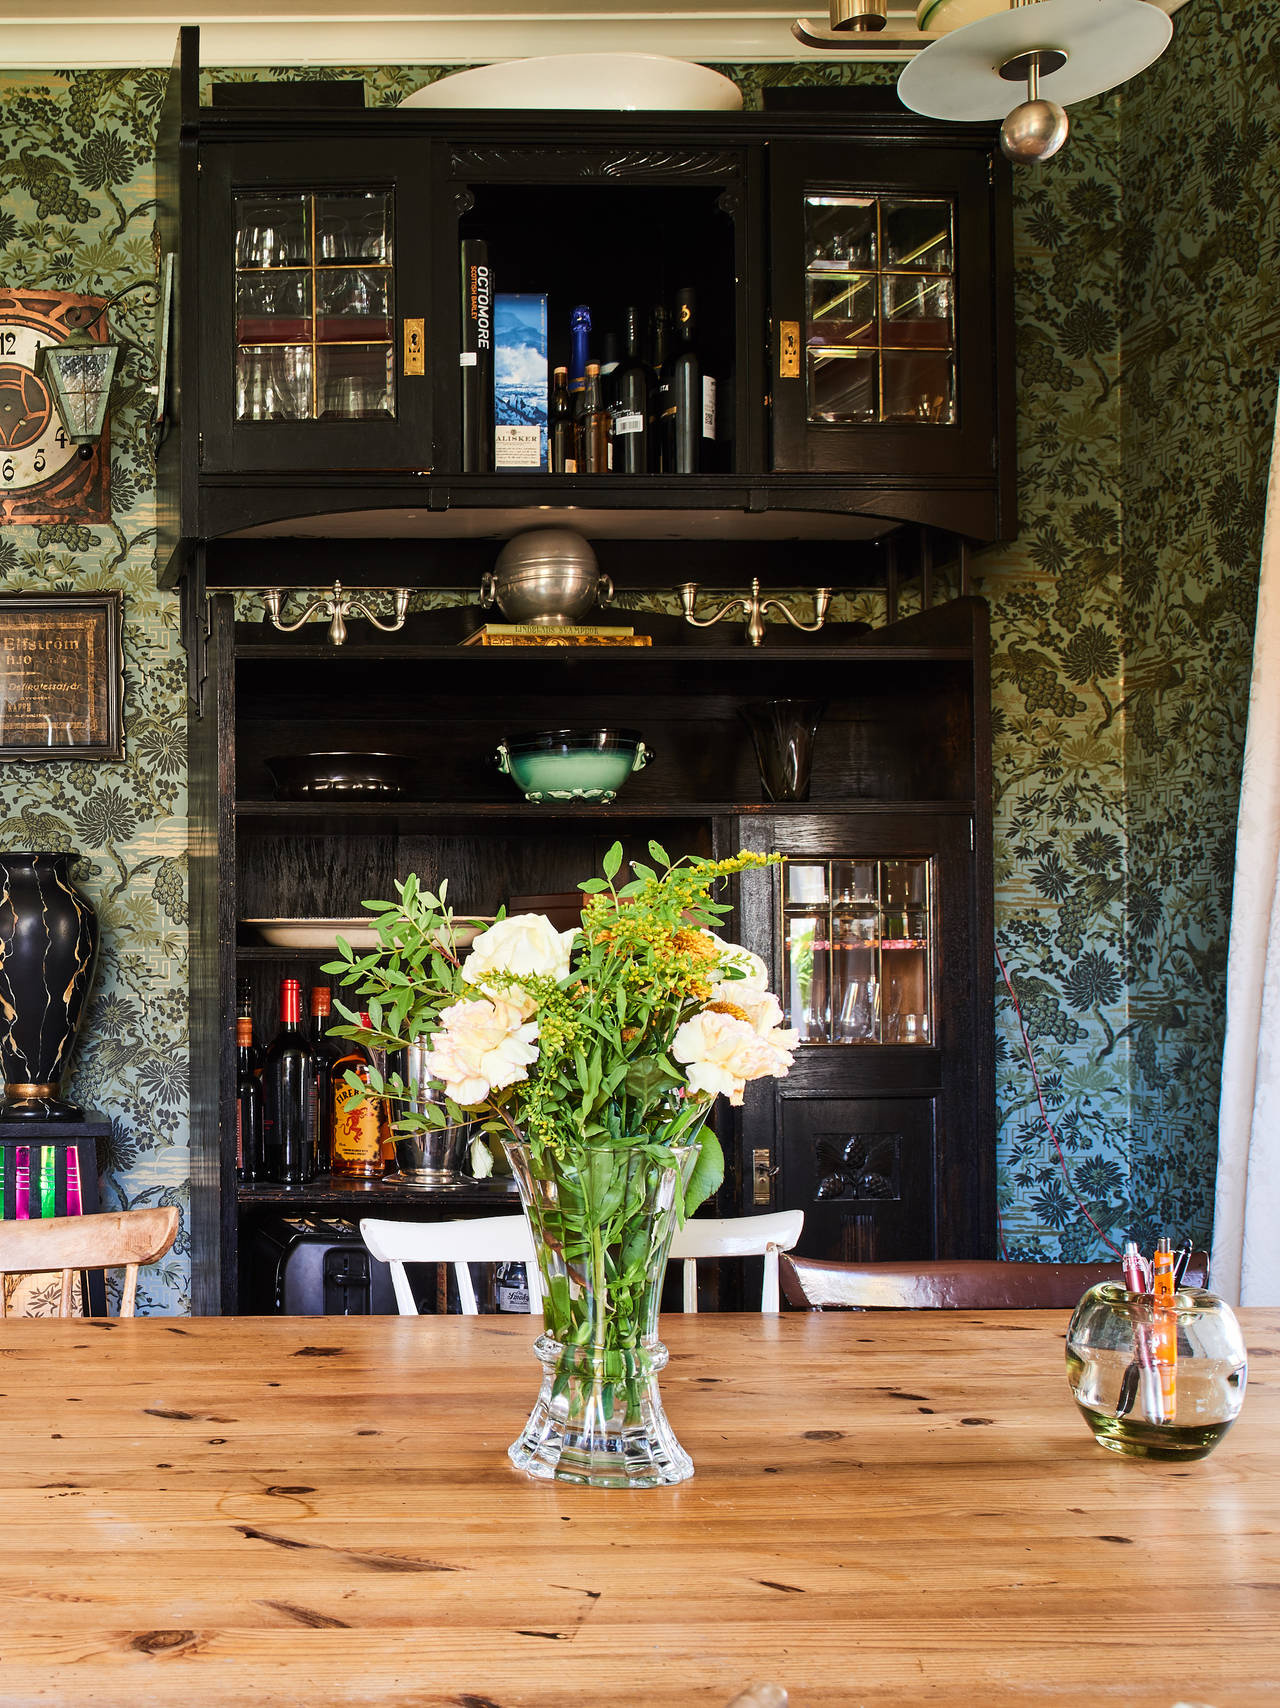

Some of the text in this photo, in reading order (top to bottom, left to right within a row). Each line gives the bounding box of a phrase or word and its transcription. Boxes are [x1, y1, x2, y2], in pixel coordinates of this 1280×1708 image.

[470, 265, 478, 320] SCOTTISH BARLEY
[477, 265, 490, 350] OCTOMORE
[55, 426, 68, 449] 4
[2, 458, 15, 481] 6
[33, 449, 46, 472] 5
